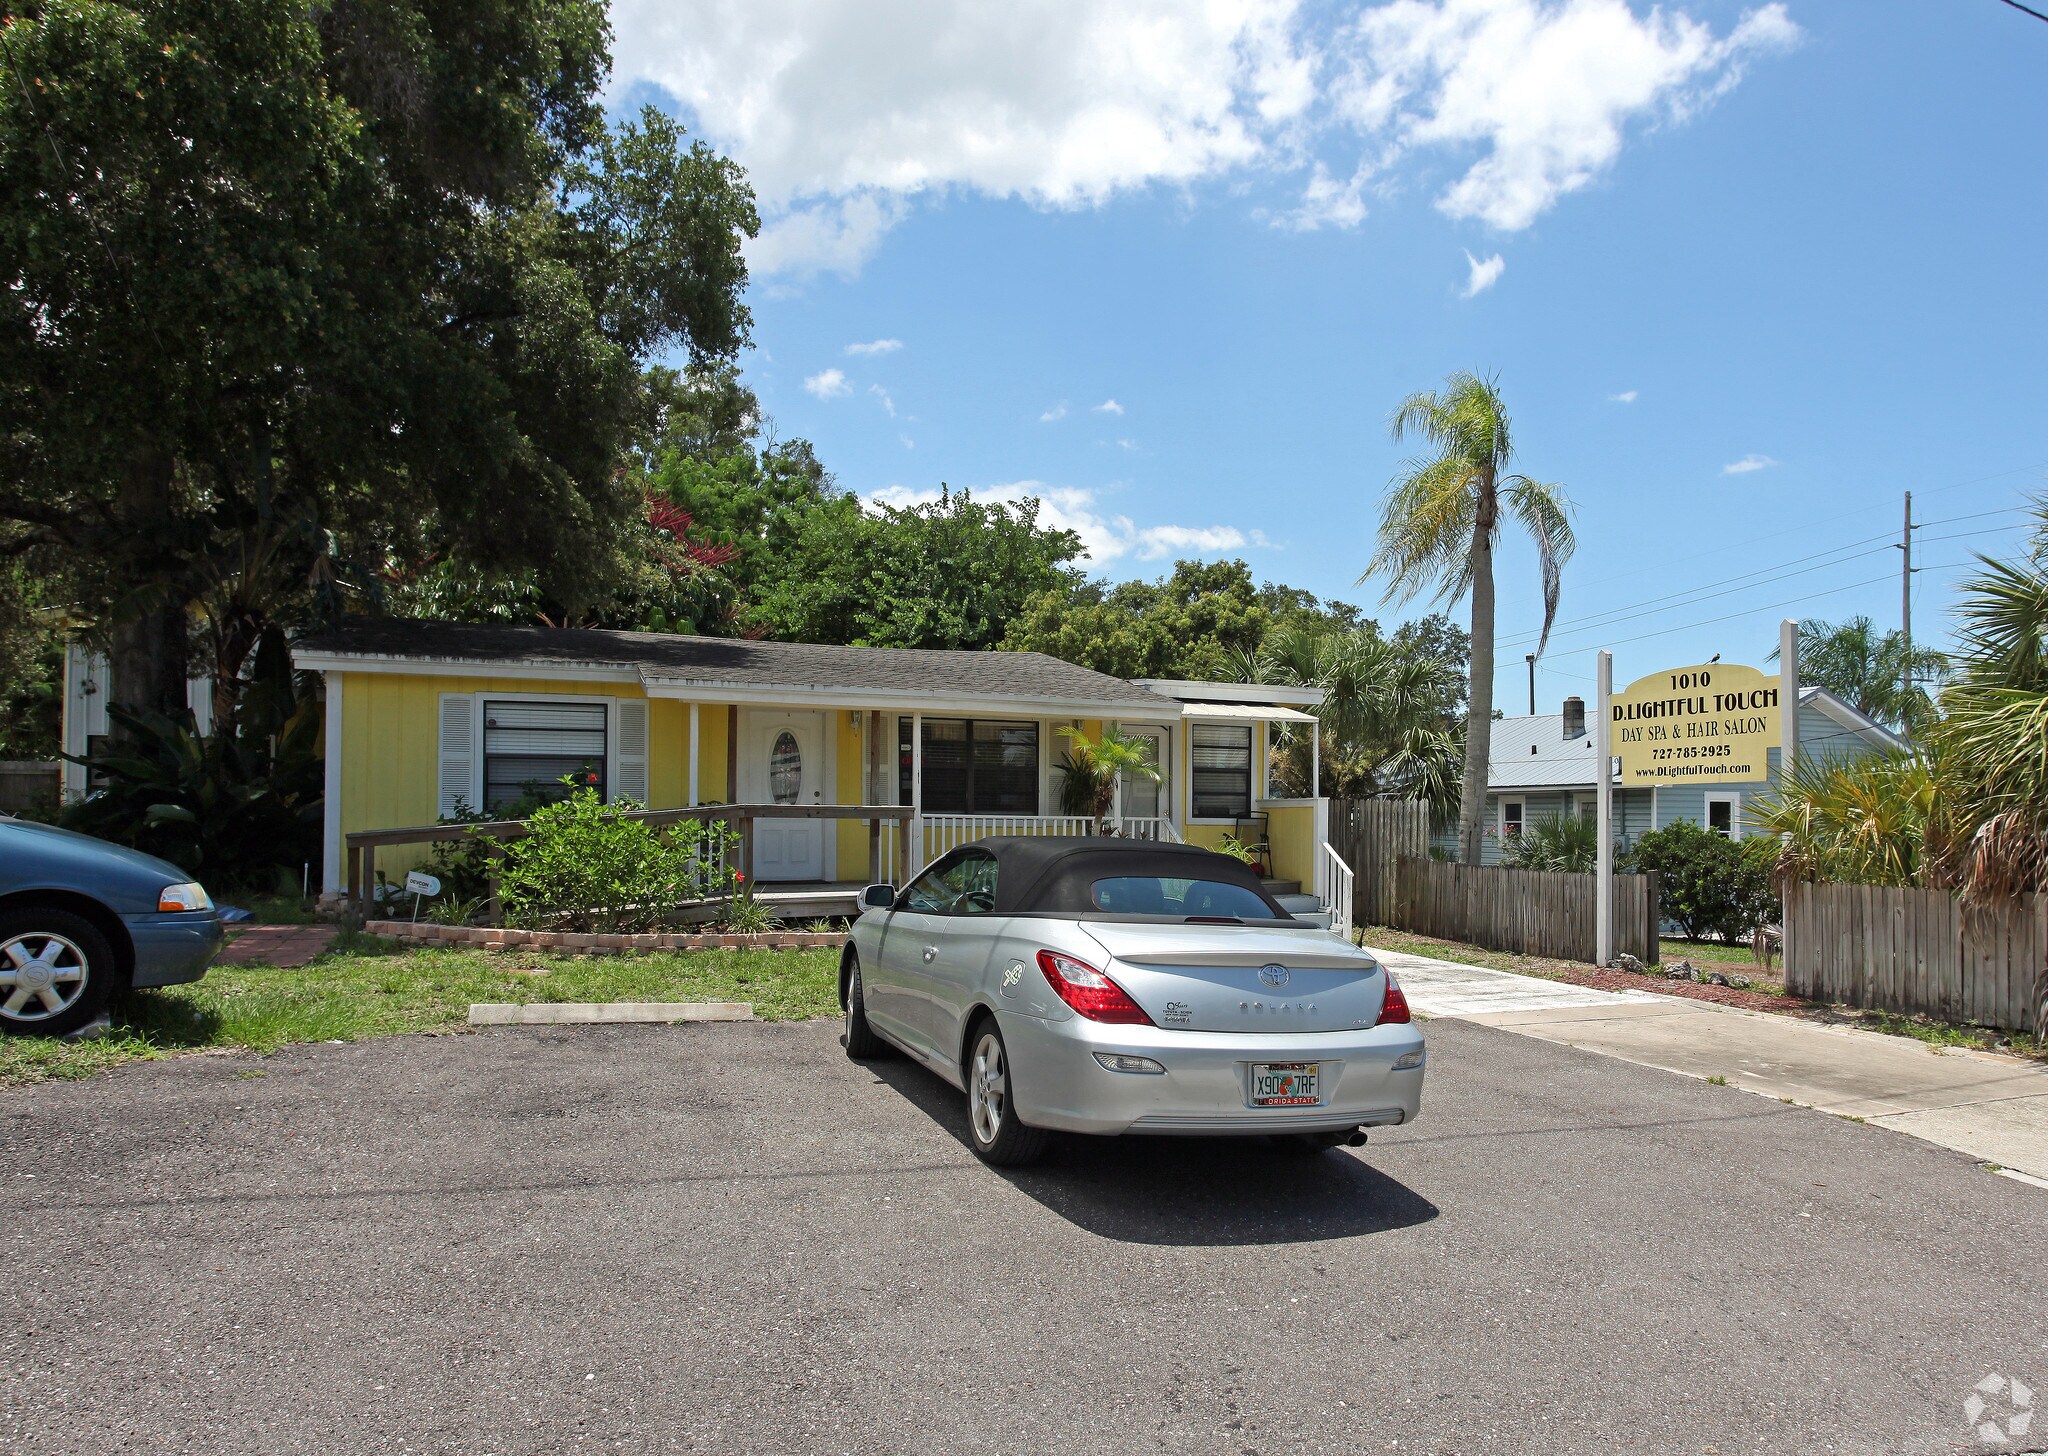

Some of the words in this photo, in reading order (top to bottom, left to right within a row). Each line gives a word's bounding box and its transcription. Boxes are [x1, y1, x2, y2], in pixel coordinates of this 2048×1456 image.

[1670, 671, 1711, 690] 1010
[1612, 696, 1709, 722] D.LIGHTFUL
[1713, 688, 1778, 713] TOUCH
[1621, 727, 1643, 743] DAY
[1648, 725, 1667, 742] SPA
[1672, 724, 1681, 739] &
[1687, 721, 1719, 738] HAIR
[1724, 716, 1767, 736] SALON
[1652, 744, 1731, 760] 727-785-2925
[1635, 763, 1751, 778] www.DLightfulTouch.com
